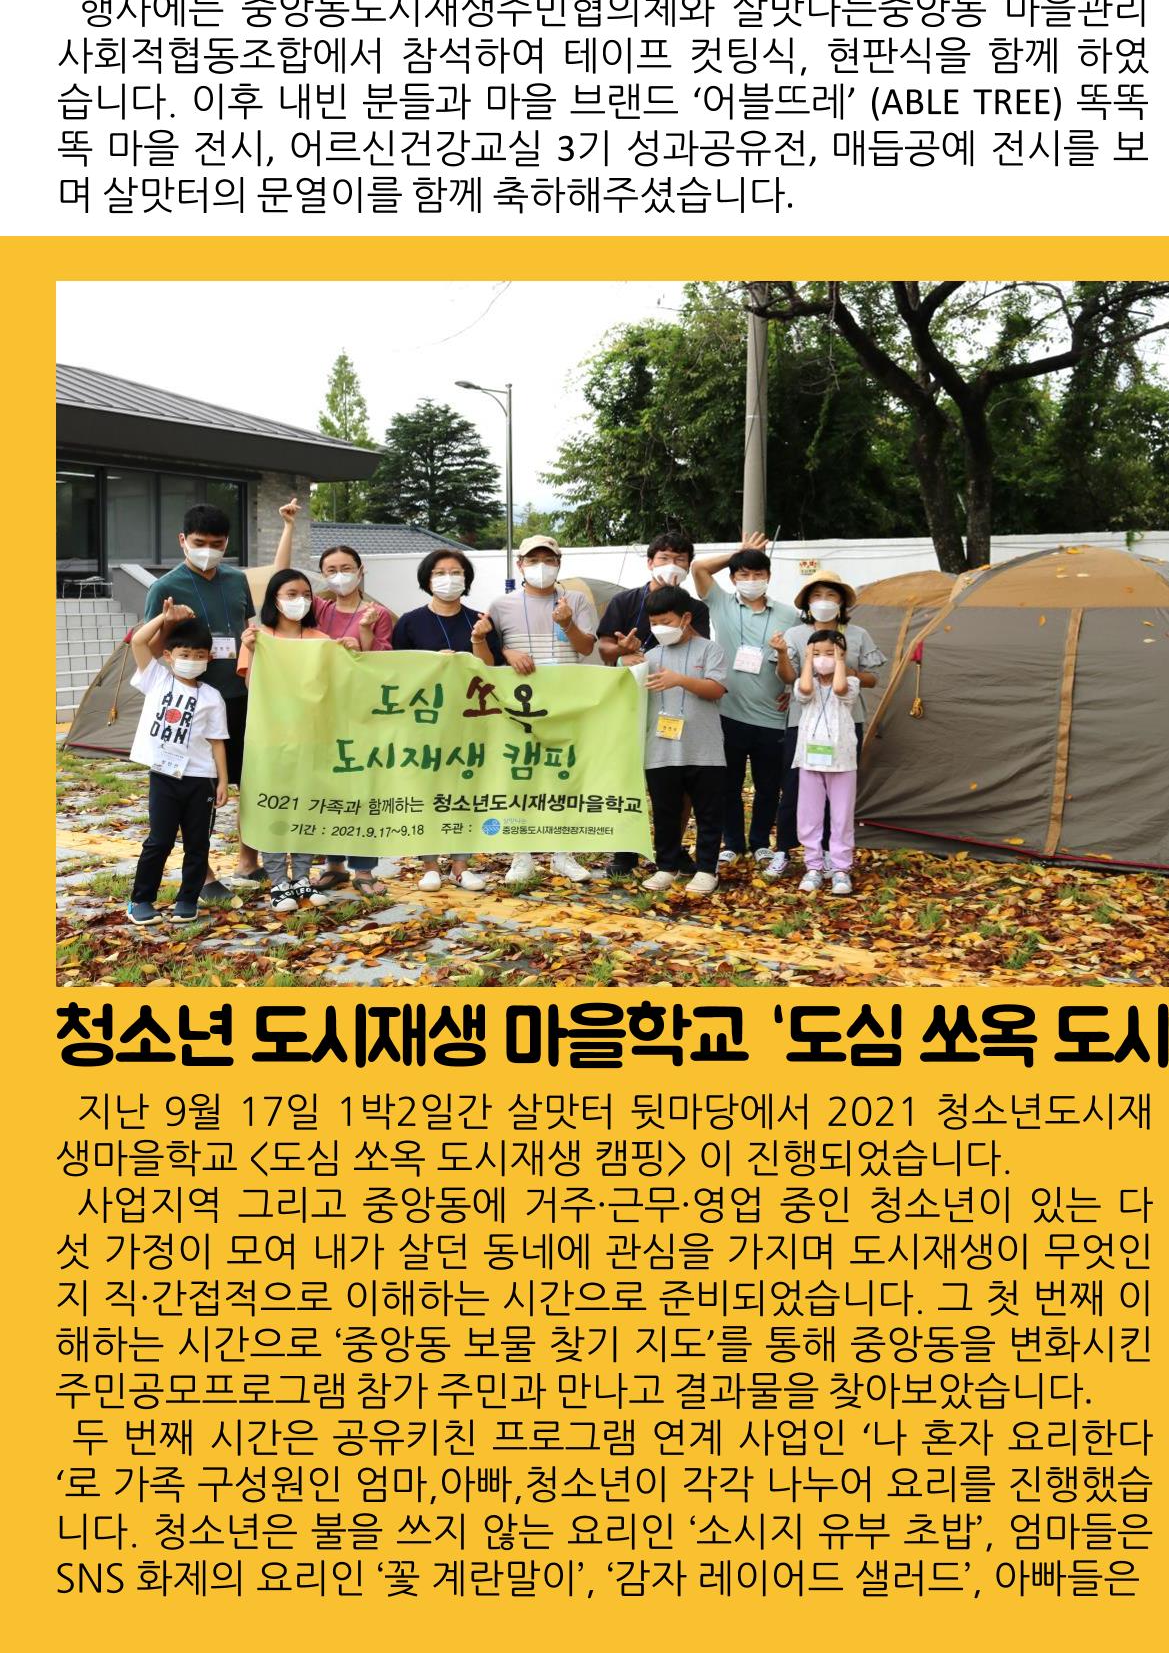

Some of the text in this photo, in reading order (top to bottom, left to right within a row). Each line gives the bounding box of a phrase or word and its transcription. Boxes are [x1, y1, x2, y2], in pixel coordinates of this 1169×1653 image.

[61, 177, 792, 214] 며 살맛터의 문열이를 함께 축하해주셨습니다.
[161, 691, 197, 713] AIR
[372, 675, 549, 734] 도심 쏘옥
[332, 739, 577, 781] 도시재생 캠핑
[257, 793, 643, 817] 2021 가족과 함께하는 청소년도시재생마을학교
[291, 822, 614, 839] 기간 2021.9.17~9.18 주관 중앙동도시재생현장지원센터
[57, 1002, 234, 1067] 청소년
[252, 1004, 486, 1068] 도시재생
[506, 1001, 749, 1068] 마을학교
[774, 1004, 901, 1066] ‘도심
[920, 1004, 1037, 1068] 쏘옥
[79, 1093, 1150, 1130] 지난 9월 17일 1박2일간 살맛터 뒷마당에서 2021 청소년도시재
[57, 1140, 1009, 1177] 생마을학교 <도심 쏘옥 도시재생 캠핑> 이 진행되었습니다.
[57, 1560, 1139, 1598] SNS 화제의 요리인 ‘꽃 계란말이’, ‘감자 레이어드 샐러드’, 아빠들은
